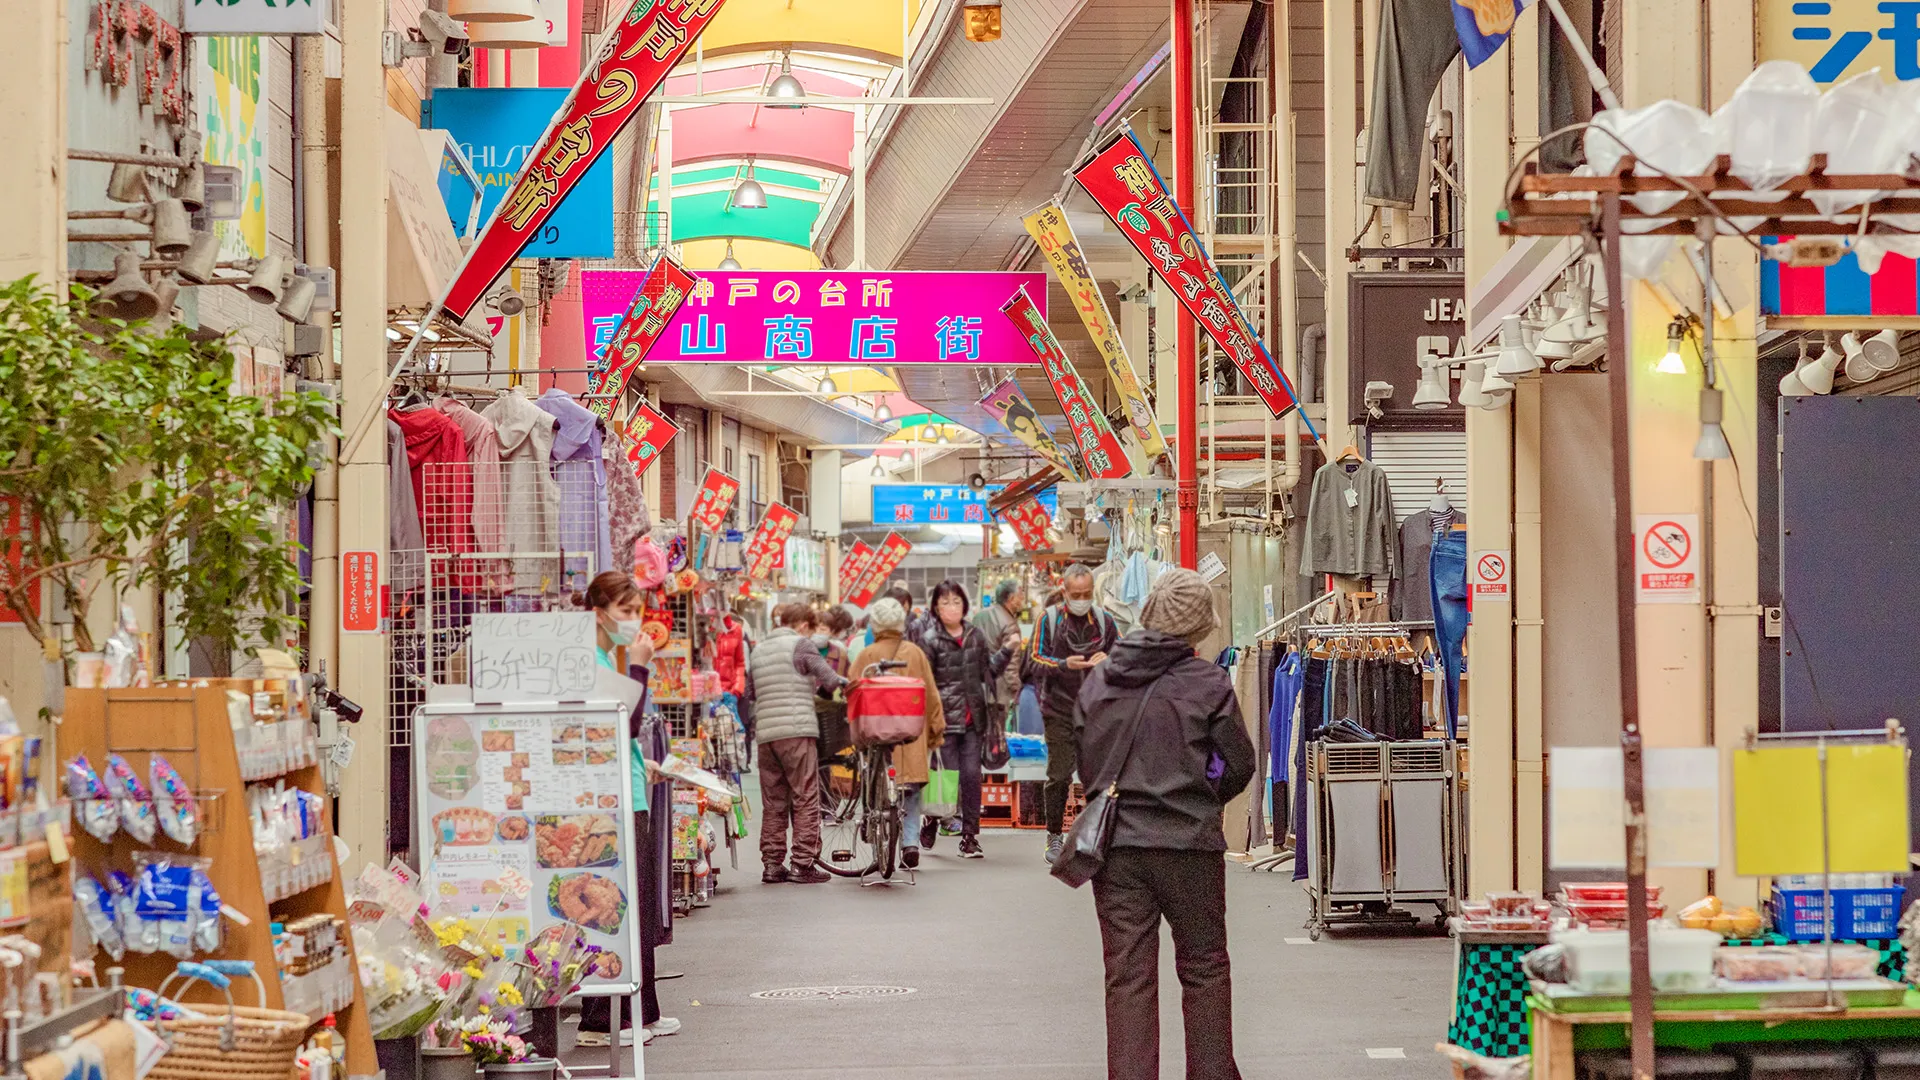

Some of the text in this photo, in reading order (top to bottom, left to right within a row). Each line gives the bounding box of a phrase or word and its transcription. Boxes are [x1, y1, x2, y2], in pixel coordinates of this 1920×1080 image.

[687, 277, 893, 307] 神戸の台所
[1150, 237, 1280, 395] 東山商店街
[1424, 298, 1466, 321] JEA
